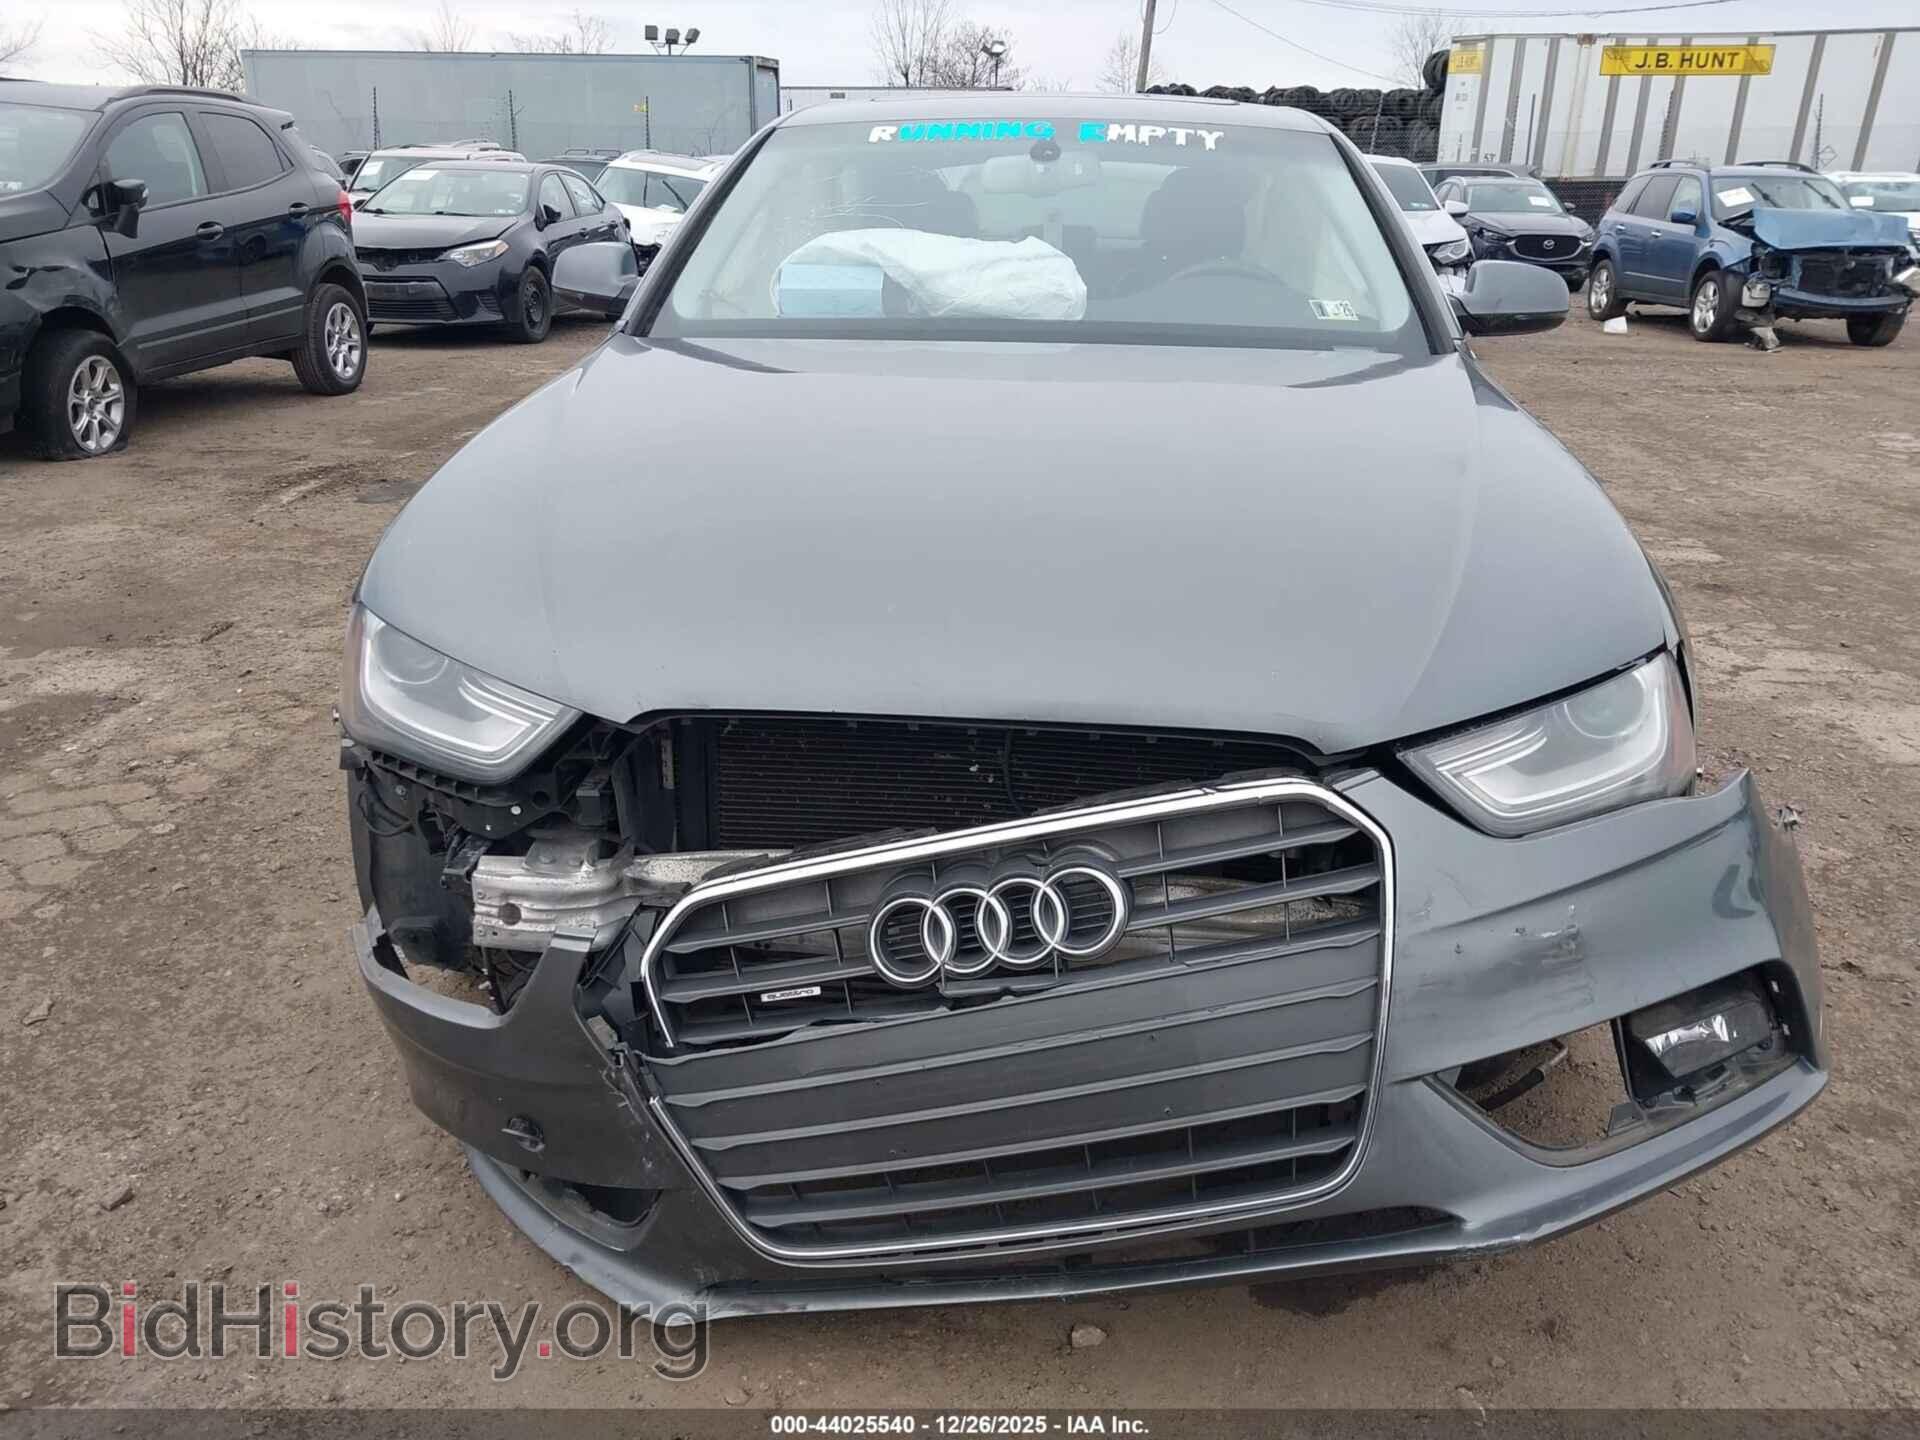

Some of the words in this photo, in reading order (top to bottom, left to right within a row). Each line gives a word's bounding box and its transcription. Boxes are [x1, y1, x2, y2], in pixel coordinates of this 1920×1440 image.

[1634, 51, 1674, 69] J.B.
[1679, 51, 1740, 69] HUNT
[867, 120, 1056, 143] RUNNING
[1078, 121, 1225, 151] EMPTY
